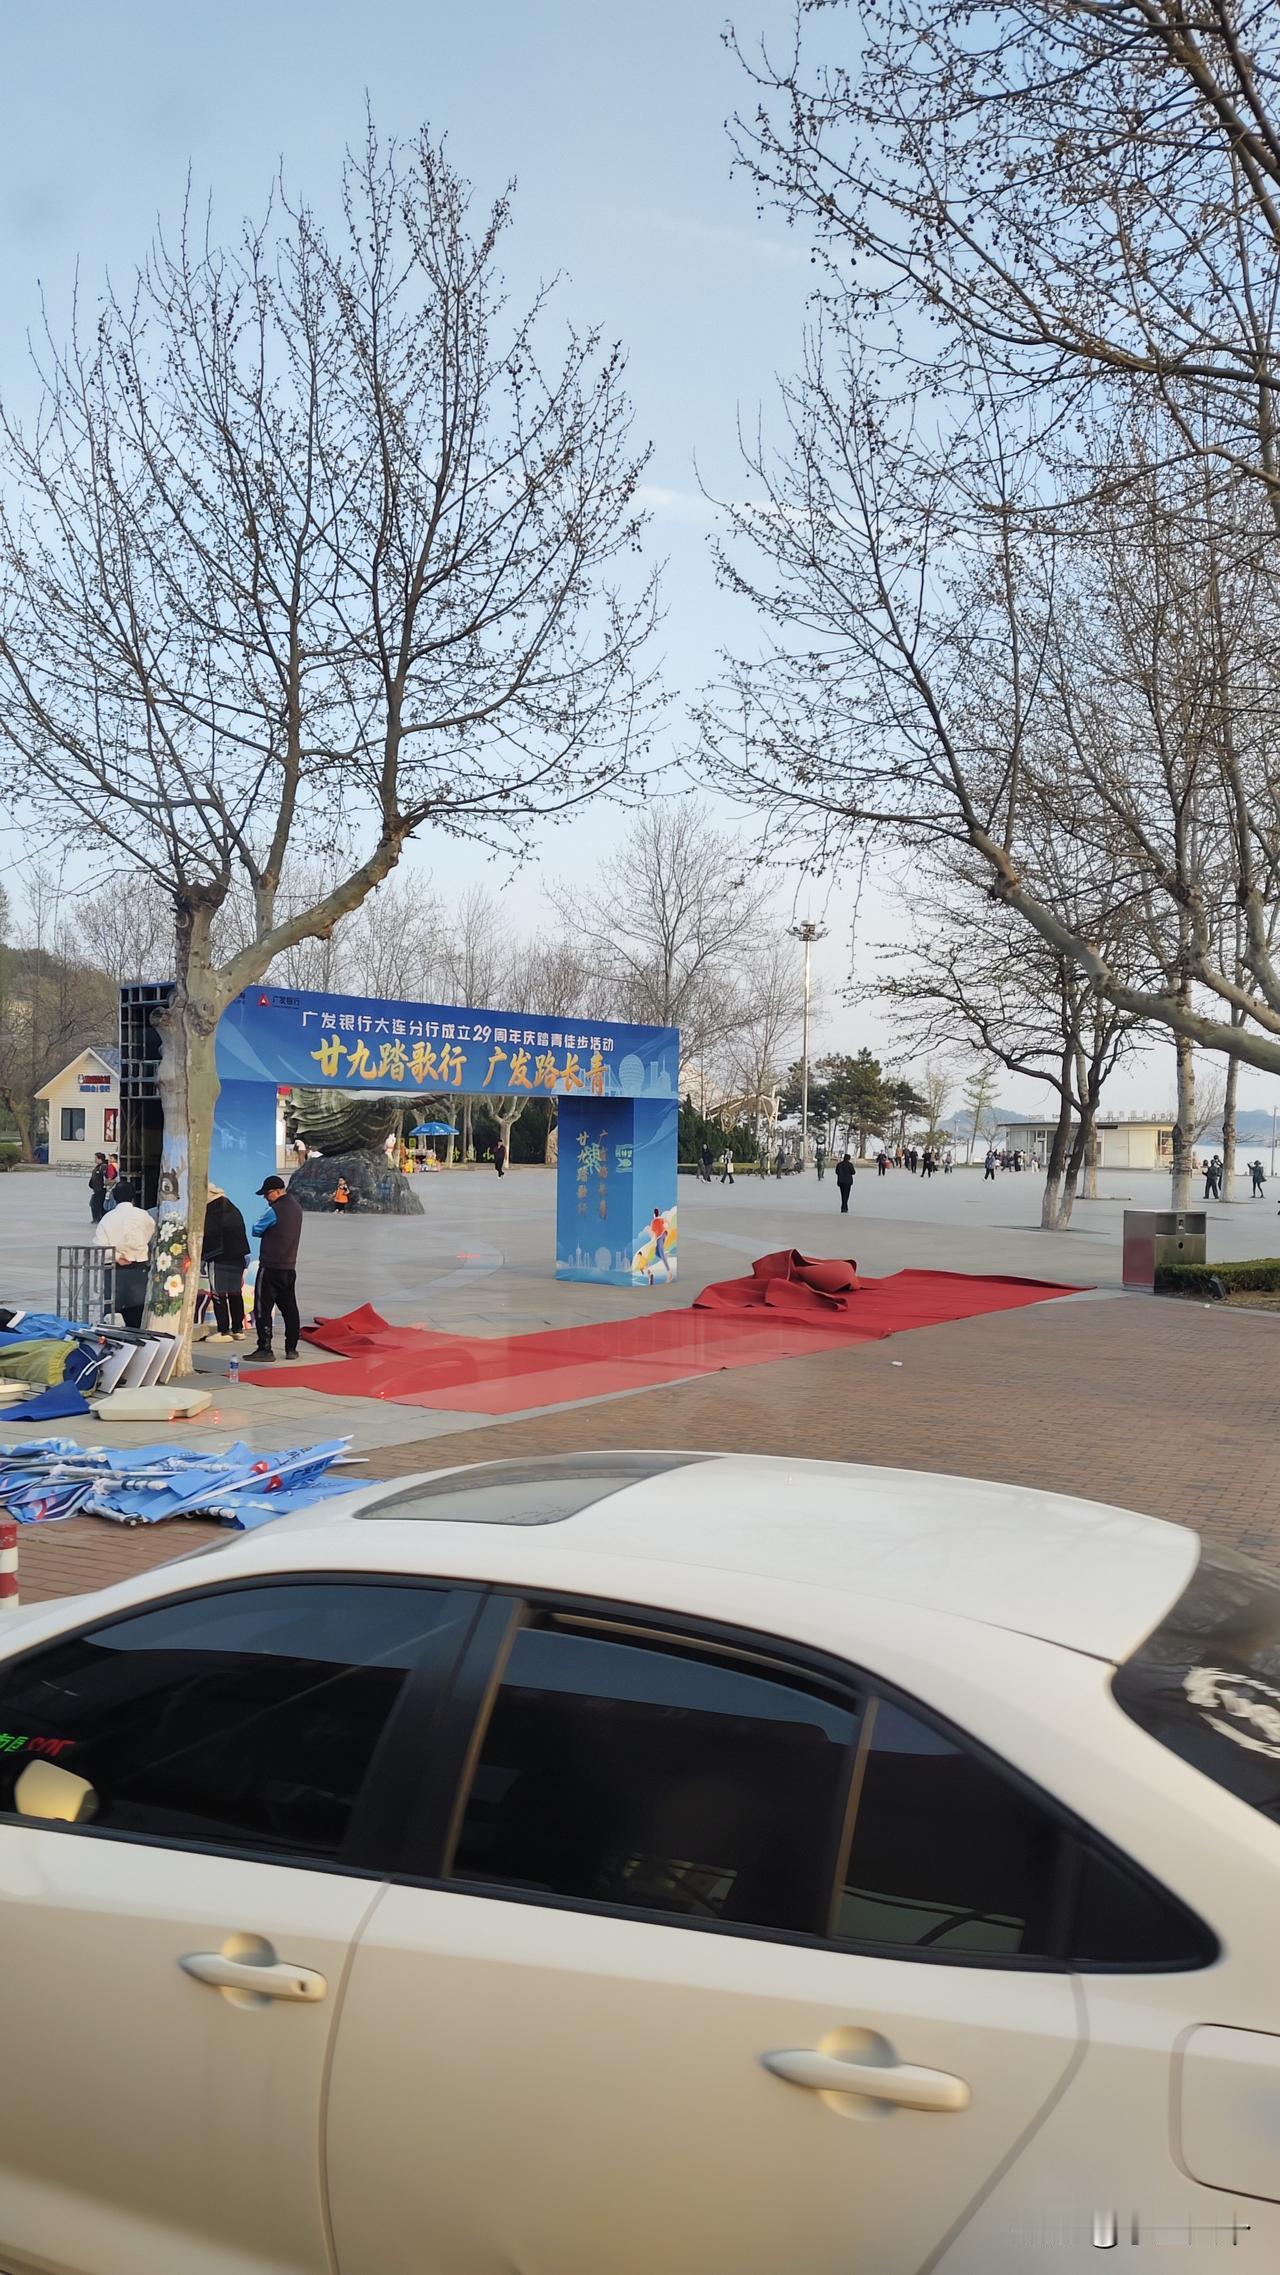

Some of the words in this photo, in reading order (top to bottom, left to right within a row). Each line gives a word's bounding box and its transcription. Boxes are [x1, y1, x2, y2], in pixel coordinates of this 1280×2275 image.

[302, 1010, 614, 1052] 广发银行大连分行成立29周年庆踏青徒步活动
[311, 1034, 467, 1087] 廿九踏歌行
[482, 1046, 608, 1096] 广发路长青
